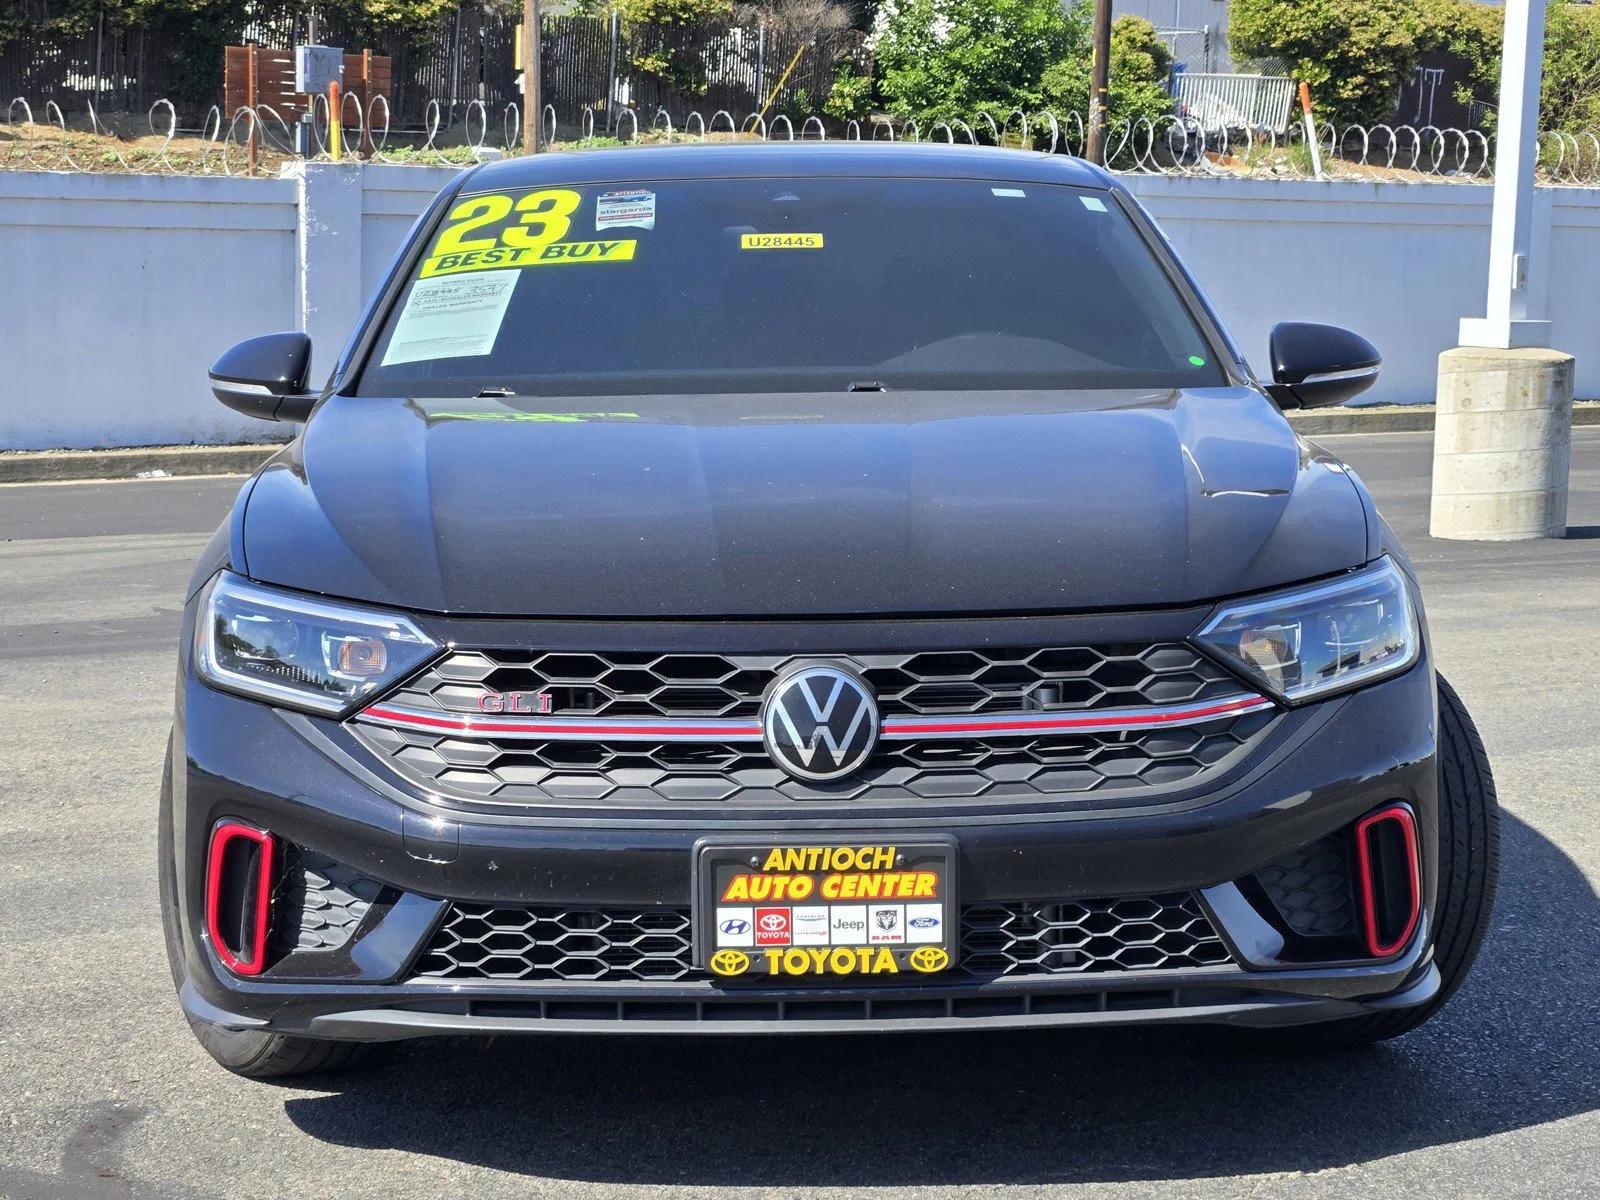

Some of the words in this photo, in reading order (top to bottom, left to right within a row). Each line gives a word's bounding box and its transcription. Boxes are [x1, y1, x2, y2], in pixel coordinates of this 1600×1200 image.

[432, 189, 582, 258] 23
[748, 237, 815, 247] U28445
[434, 246, 532, 271] BEST
[539, 241, 623, 260] BUY
[477, 692, 552, 713] GLI
[762, 847, 896, 871] ANTIOCH
[723, 875, 814, 901] AUTO
[822, 872, 938, 898] CENTER
[833, 918, 865, 931] Jeep
[914, 919, 934, 928] Ford
[765, 947, 899, 975] TOYOTA
